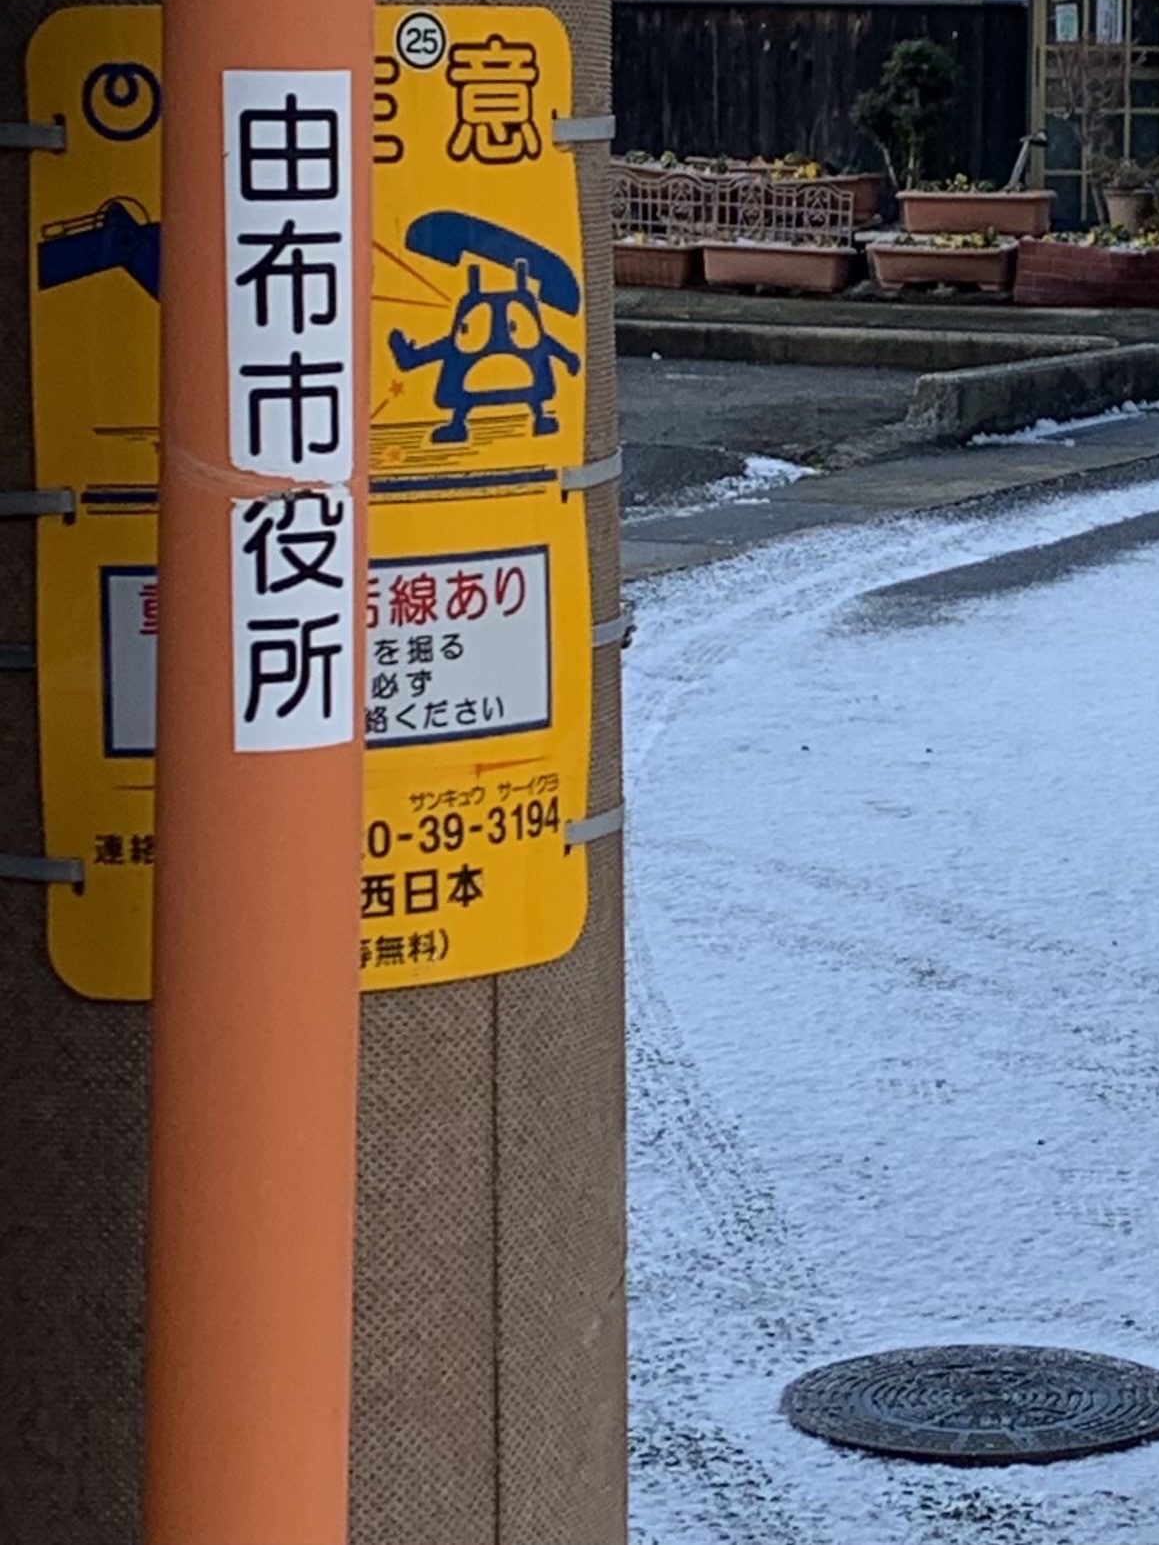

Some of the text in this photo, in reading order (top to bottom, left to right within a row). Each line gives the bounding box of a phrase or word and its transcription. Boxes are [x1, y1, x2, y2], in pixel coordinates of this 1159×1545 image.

[406, 27, 439, 55] 25
[234, 92, 343, 723] 由布市役所
[374, 633, 464, 667] を掘る
[371, 669, 432, 699] 必ず
[362, 796, 560, 859] 0-39-3194
[360, 863, 483, 919] 西日本
